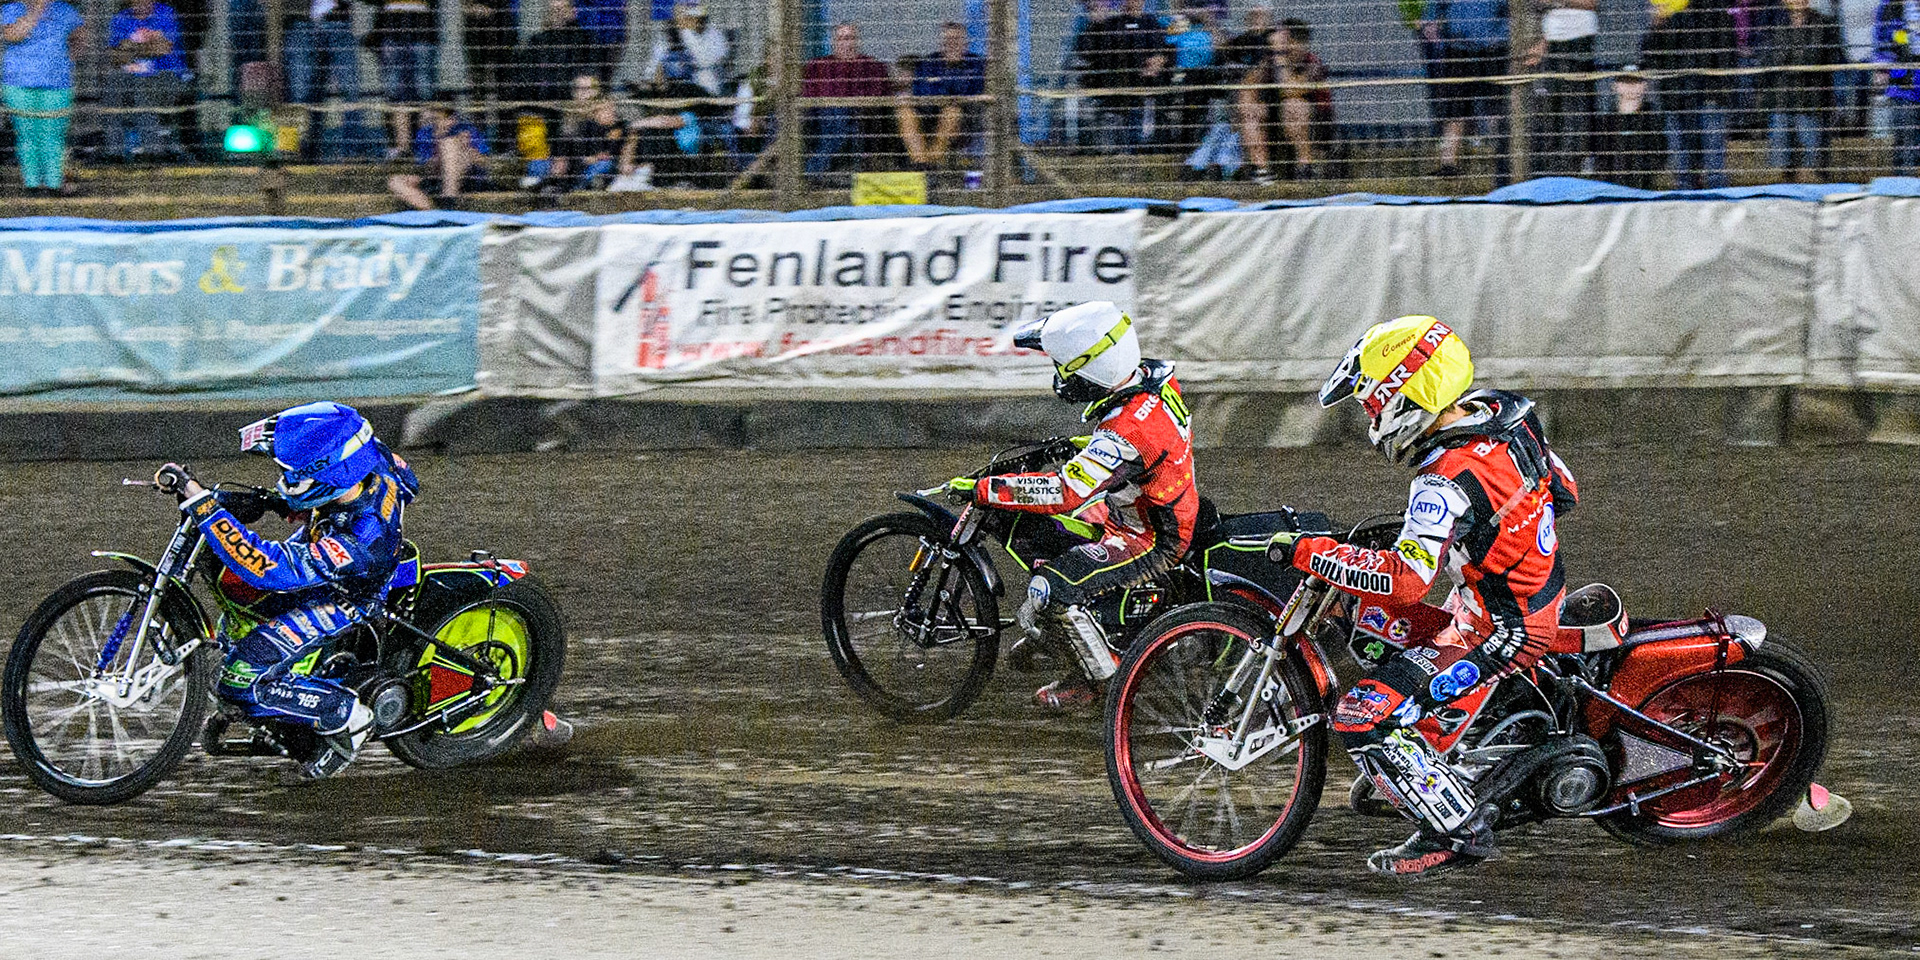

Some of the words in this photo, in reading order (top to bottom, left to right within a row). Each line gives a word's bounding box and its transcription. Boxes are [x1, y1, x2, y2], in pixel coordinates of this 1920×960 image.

[0, 248, 186, 297] Minors
[199, 245, 246, 294] &
[266, 240, 429, 301] Brady
[684, 236, 963, 290] Fenland
[993, 232, 1132, 285] Fire
[1016, 487, 1061, 495] PLASTICS
[1017, 477, 1050, 485] VISION
[1414, 501, 1441, 515] ATPI
[215, 520, 273, 571] DUCHY
